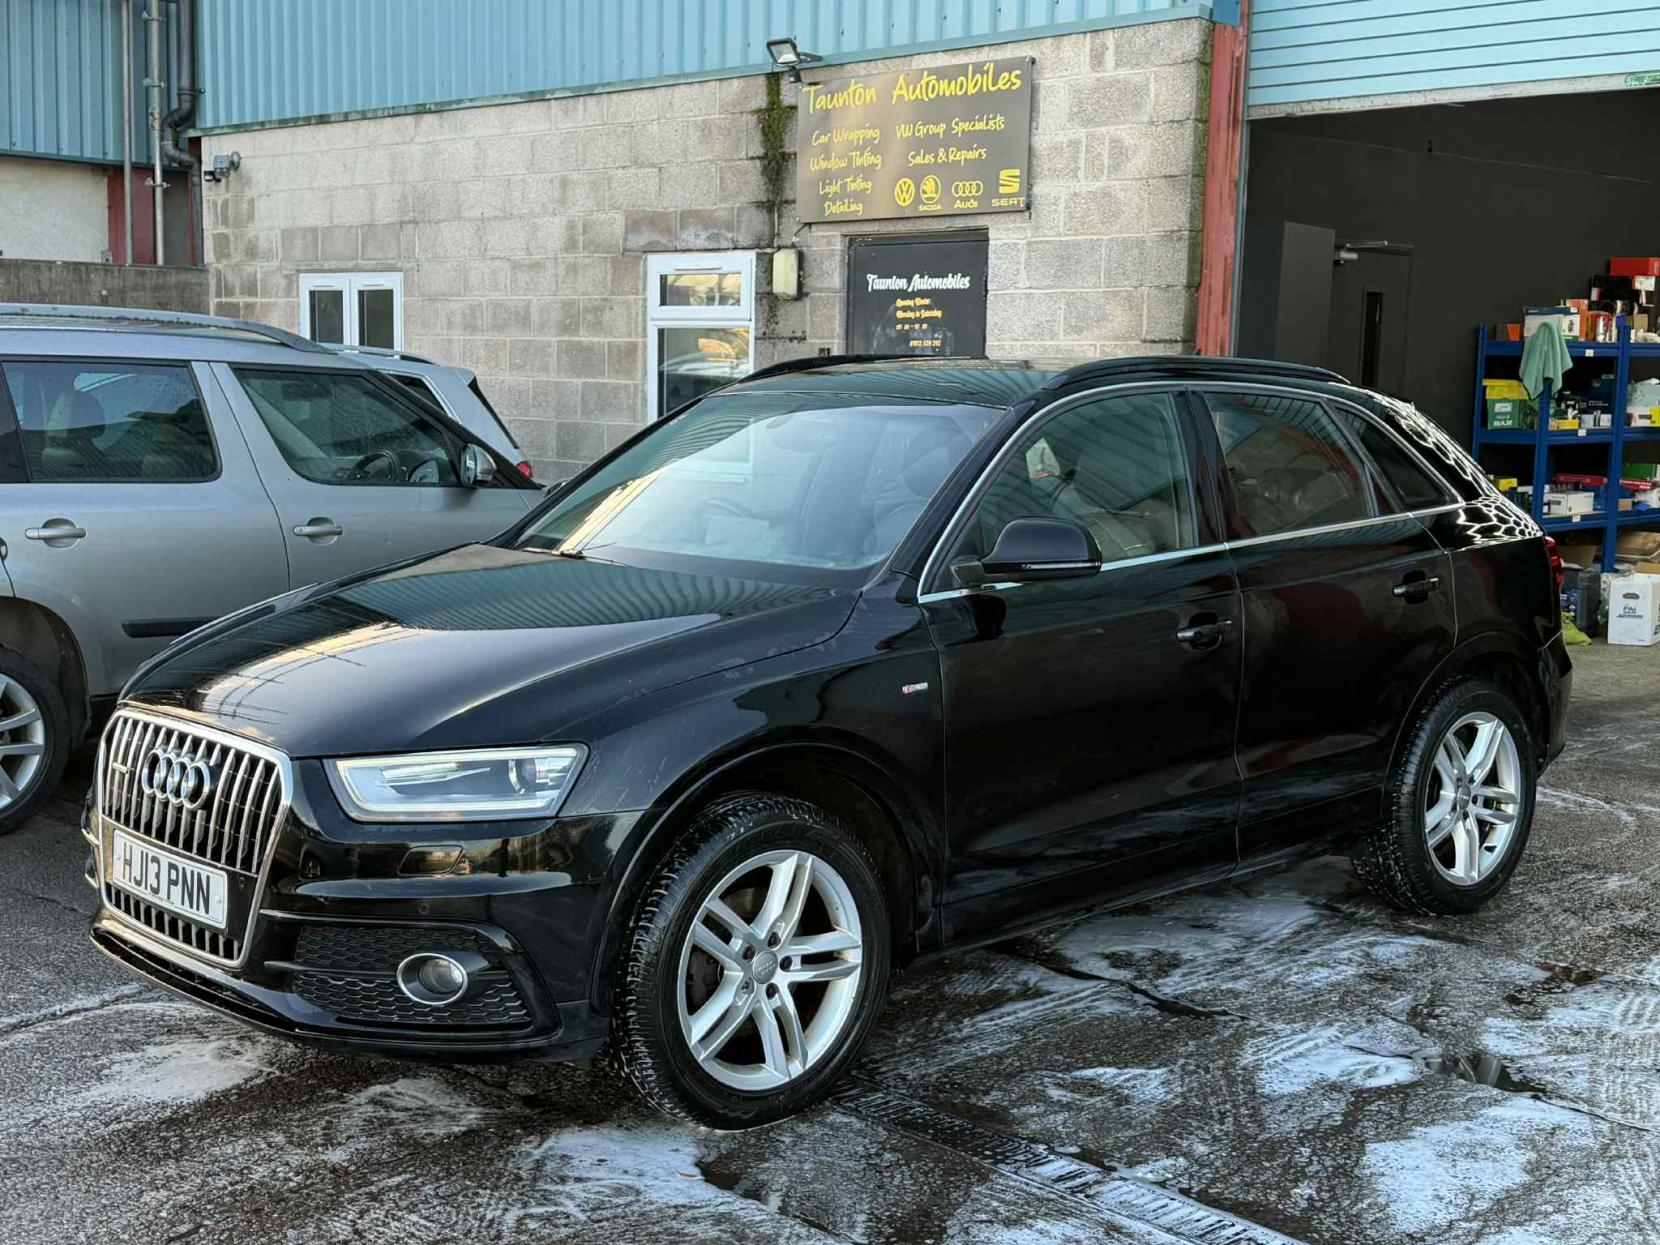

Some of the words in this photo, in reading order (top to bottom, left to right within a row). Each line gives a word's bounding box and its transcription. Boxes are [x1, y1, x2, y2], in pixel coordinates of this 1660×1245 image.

[801, 79, 876, 114] Taunton
[892, 62, 1022, 105] Automobiles
[812, 130, 832, 146] Car
[832, 123, 881, 146] Wrapping
[915, 121, 946, 139] Group
[951, 112, 1005, 137] Specialists
[810, 152, 848, 171] Window
[849, 146, 882, 170] Tinting
[908, 149, 935, 167] Sales
[937, 147, 947, 163] &
[948, 143, 987, 167] Repairs
[819, 178, 843, 197] Light
[824, 198, 863, 216] Detailing
[954, 198, 978, 209] Audi
[991, 197, 1025, 207] SEAT
[866, 273, 908, 292] Taunton
[907, 273, 971, 292] Automobiles
[122, 842, 162, 895] HJ13
[167, 862, 211, 915] PNN
